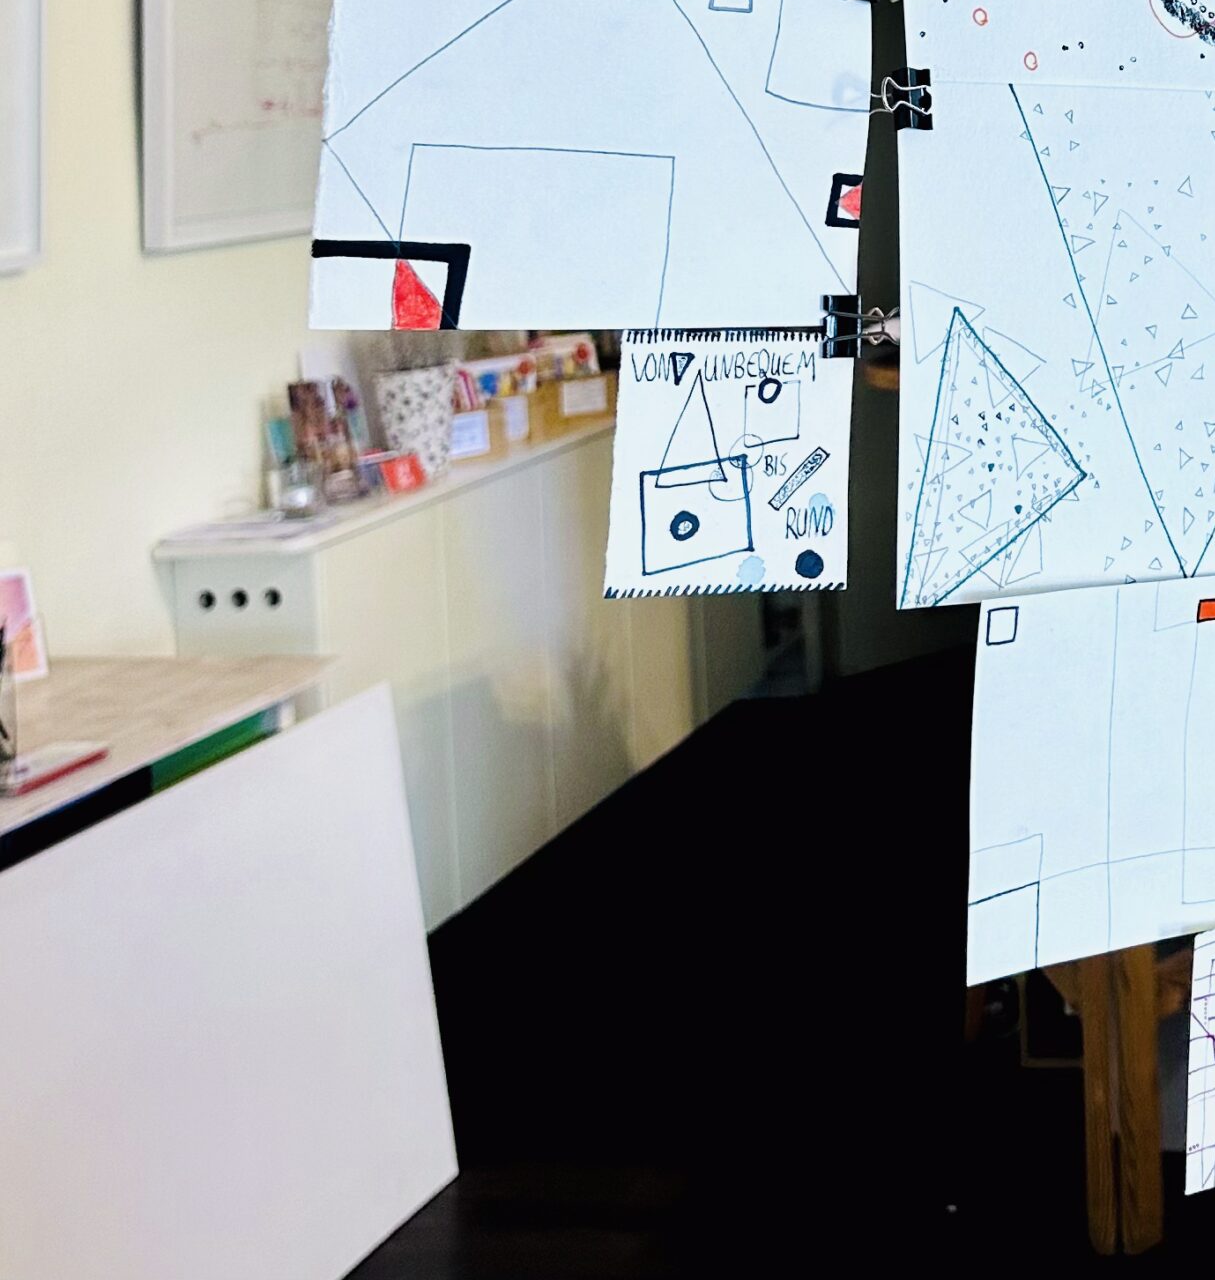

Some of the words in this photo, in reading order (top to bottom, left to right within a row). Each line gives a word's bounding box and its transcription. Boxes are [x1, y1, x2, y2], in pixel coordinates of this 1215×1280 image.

[631, 352, 671, 382] VON
[704, 348, 816, 382] UNBEQUEM
[763, 452, 788, 477] BIS
[785, 505, 834, 539] RUND
